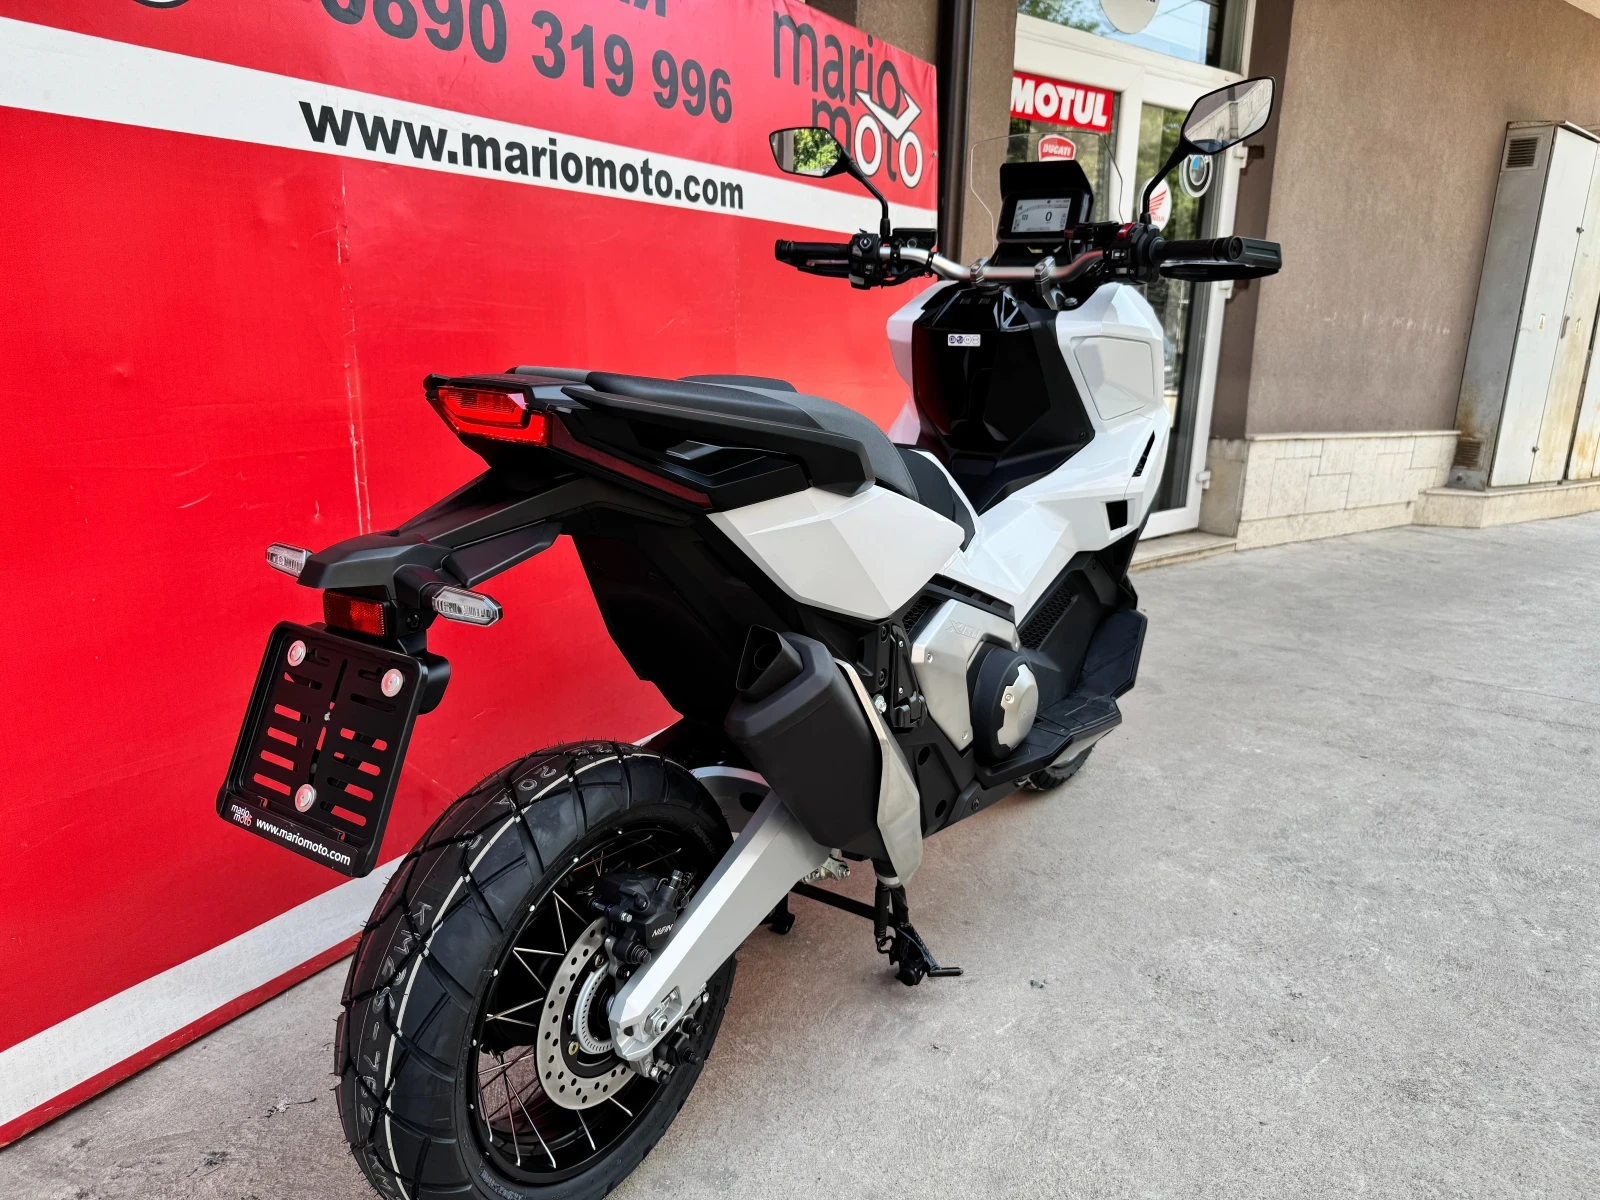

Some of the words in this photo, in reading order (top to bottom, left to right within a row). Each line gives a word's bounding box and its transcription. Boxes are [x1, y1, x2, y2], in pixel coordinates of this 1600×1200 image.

[531, 10, 634, 98] 319
[651, 49, 733, 124] 996
[773, 10, 901, 119] mario
[1010, 76, 1109, 127] MOTUL
[299, 100, 744, 210] www.mariomoto.com
[1042, 143, 1072, 157] DUCATI
[1044, 211, 1053, 222] 0
[230, 803, 251, 818] mario
[255, 818, 351, 866] www.mariomoto.com
